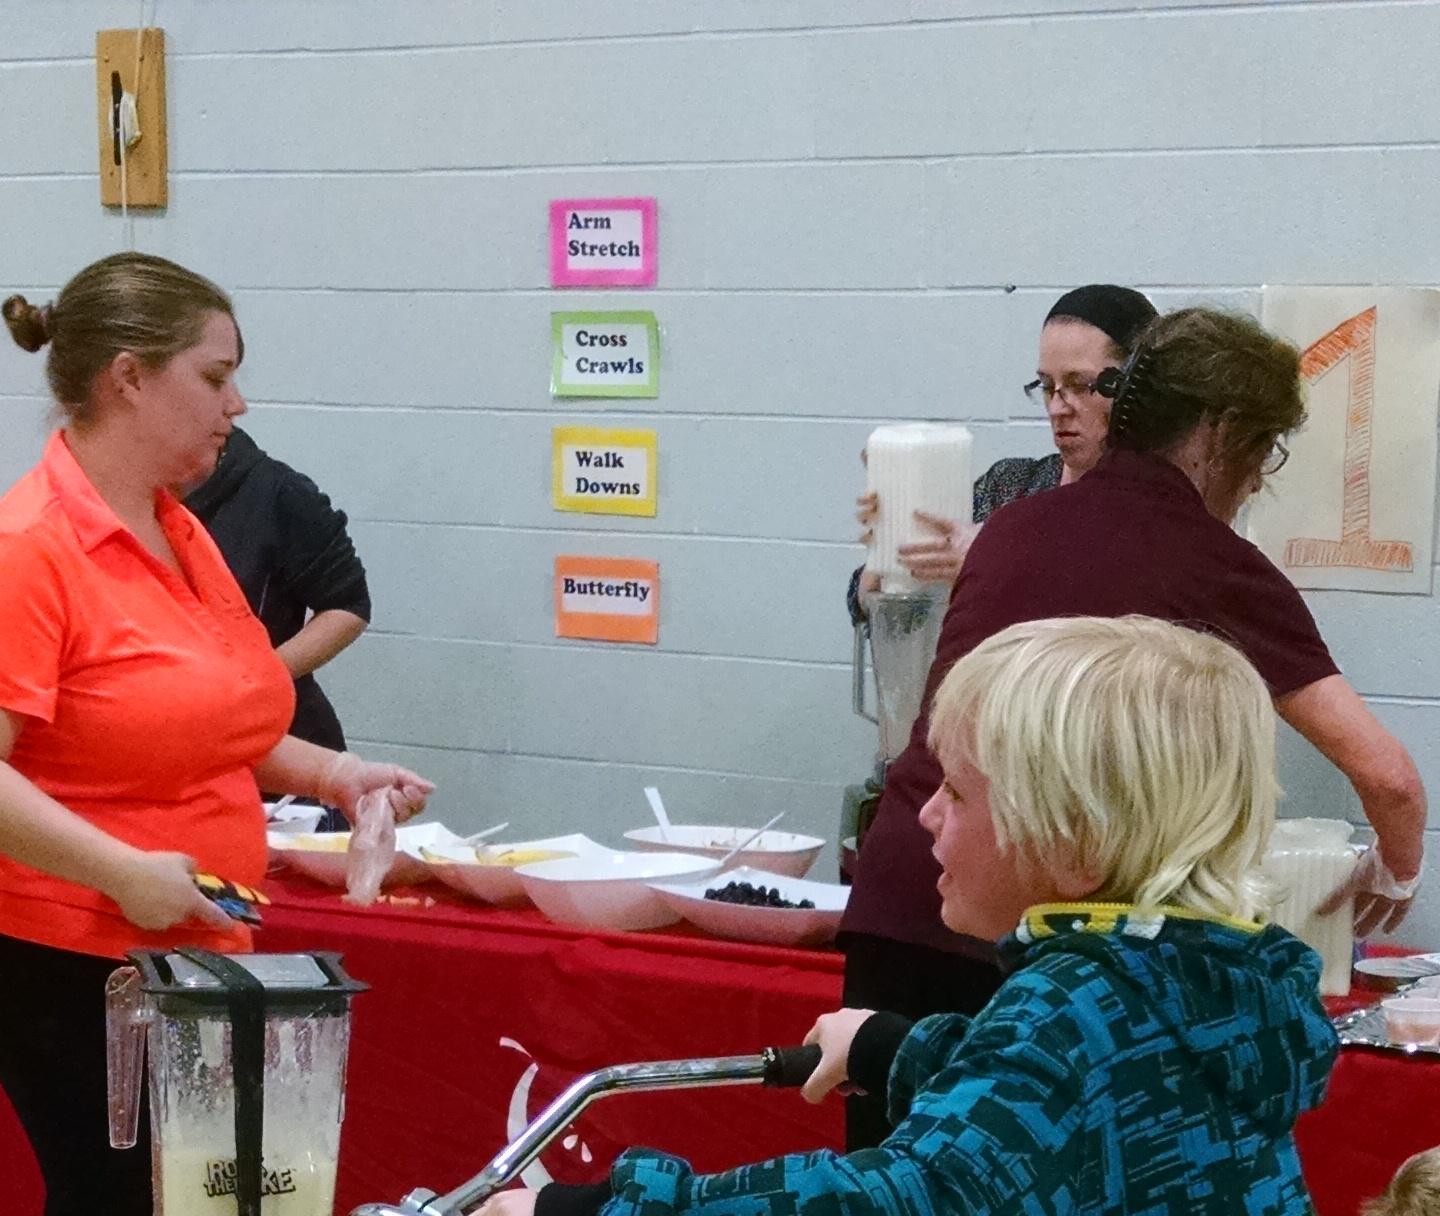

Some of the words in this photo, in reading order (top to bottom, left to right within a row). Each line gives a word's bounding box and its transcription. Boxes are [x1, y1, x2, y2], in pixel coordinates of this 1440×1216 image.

[568, 212, 611, 229] Arm
[568, 239, 641, 257] Stretch
[575, 330, 628, 348] Cross
[575, 357, 645, 374] Crawls
[1284, 306, 1414, 572] 1
[575, 451, 624, 469] Walk
[575, 477, 641, 495] Downs
[563, 578, 651, 602] Butterfly
